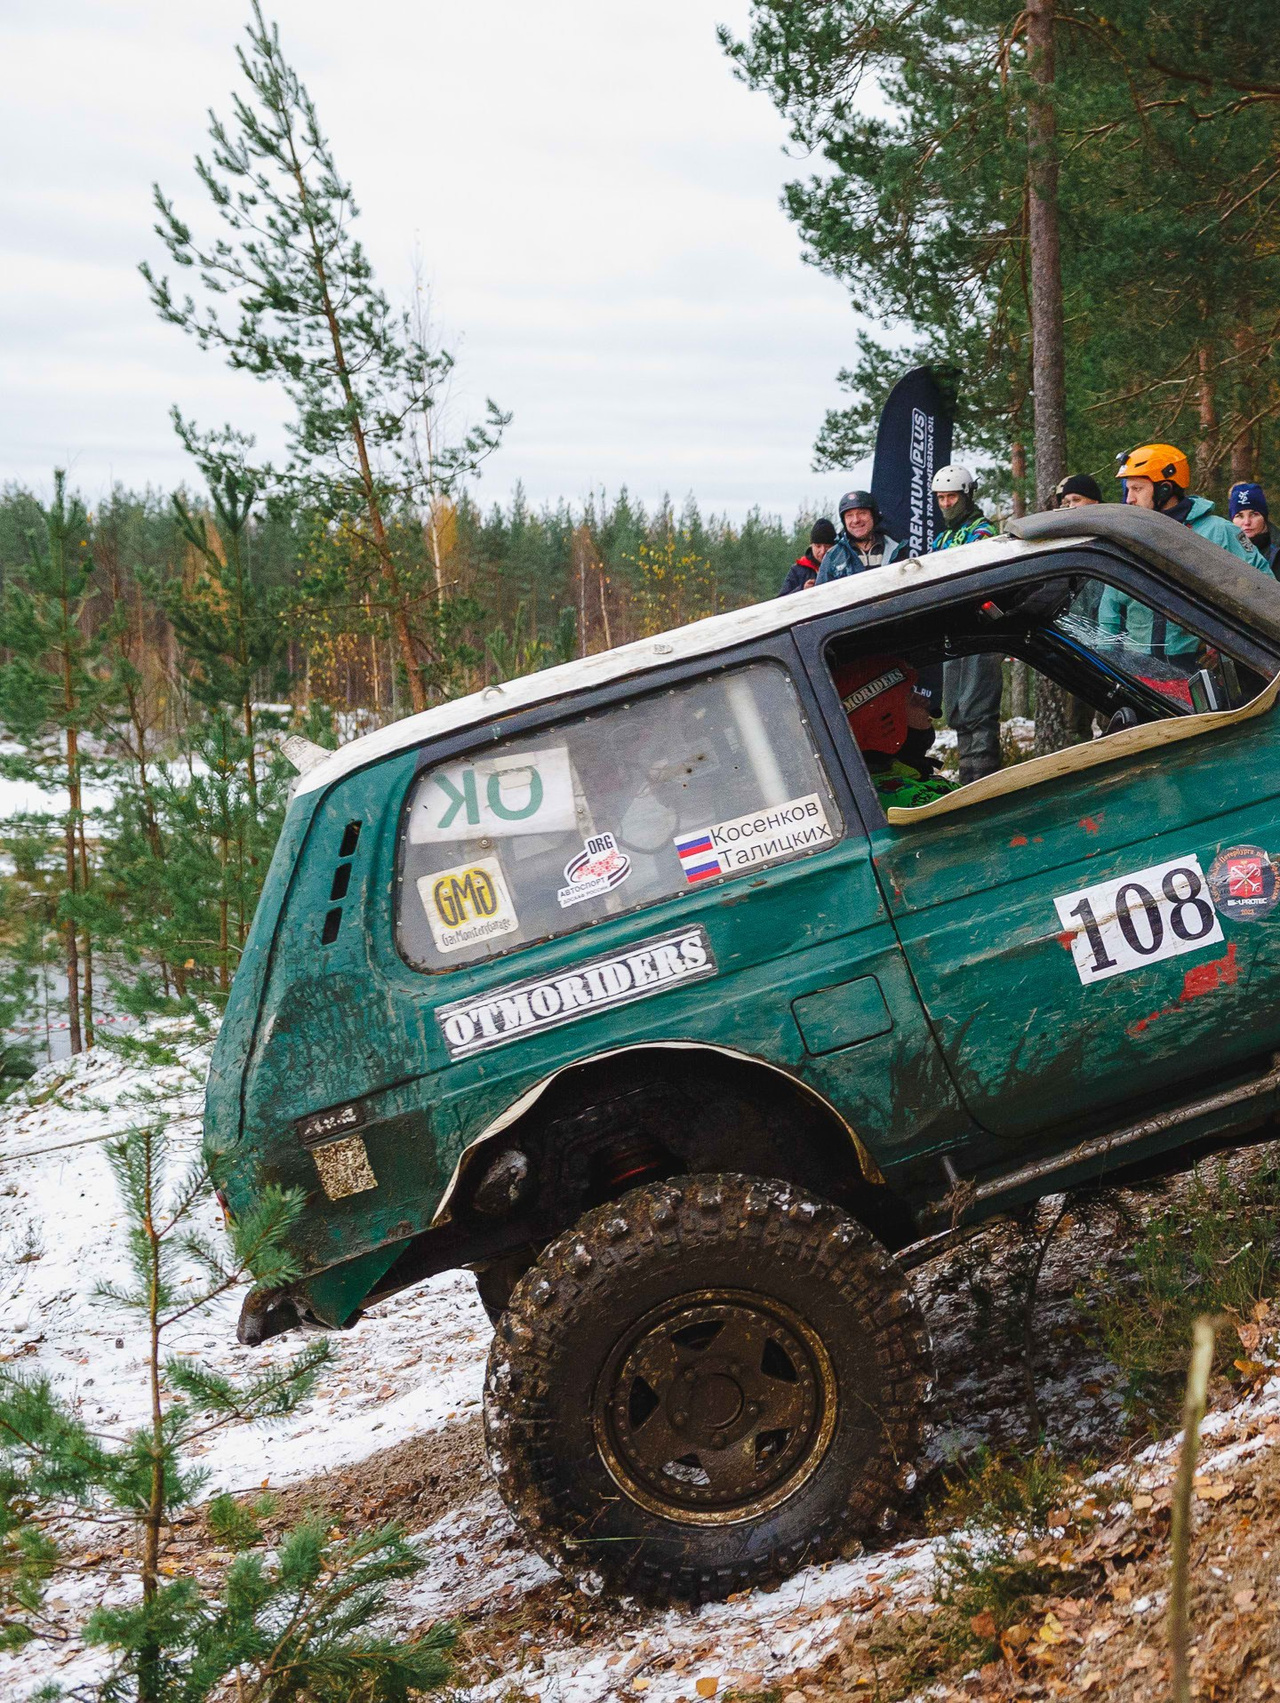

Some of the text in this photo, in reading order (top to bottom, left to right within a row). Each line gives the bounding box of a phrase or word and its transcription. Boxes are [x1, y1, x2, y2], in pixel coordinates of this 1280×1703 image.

[913, 413, 925, 465] PLUS
[843, 670, 904, 711] MORIDERS
[588, 834, 614, 855] ORG
[710, 800, 819, 846] Косенков
[716, 822, 831, 870] Талицких
[560, 876, 605, 898] АВТОСПОРТ
[1070, 867, 1215, 972] 108
[444, 936, 708, 1046] OTMORIDERS
